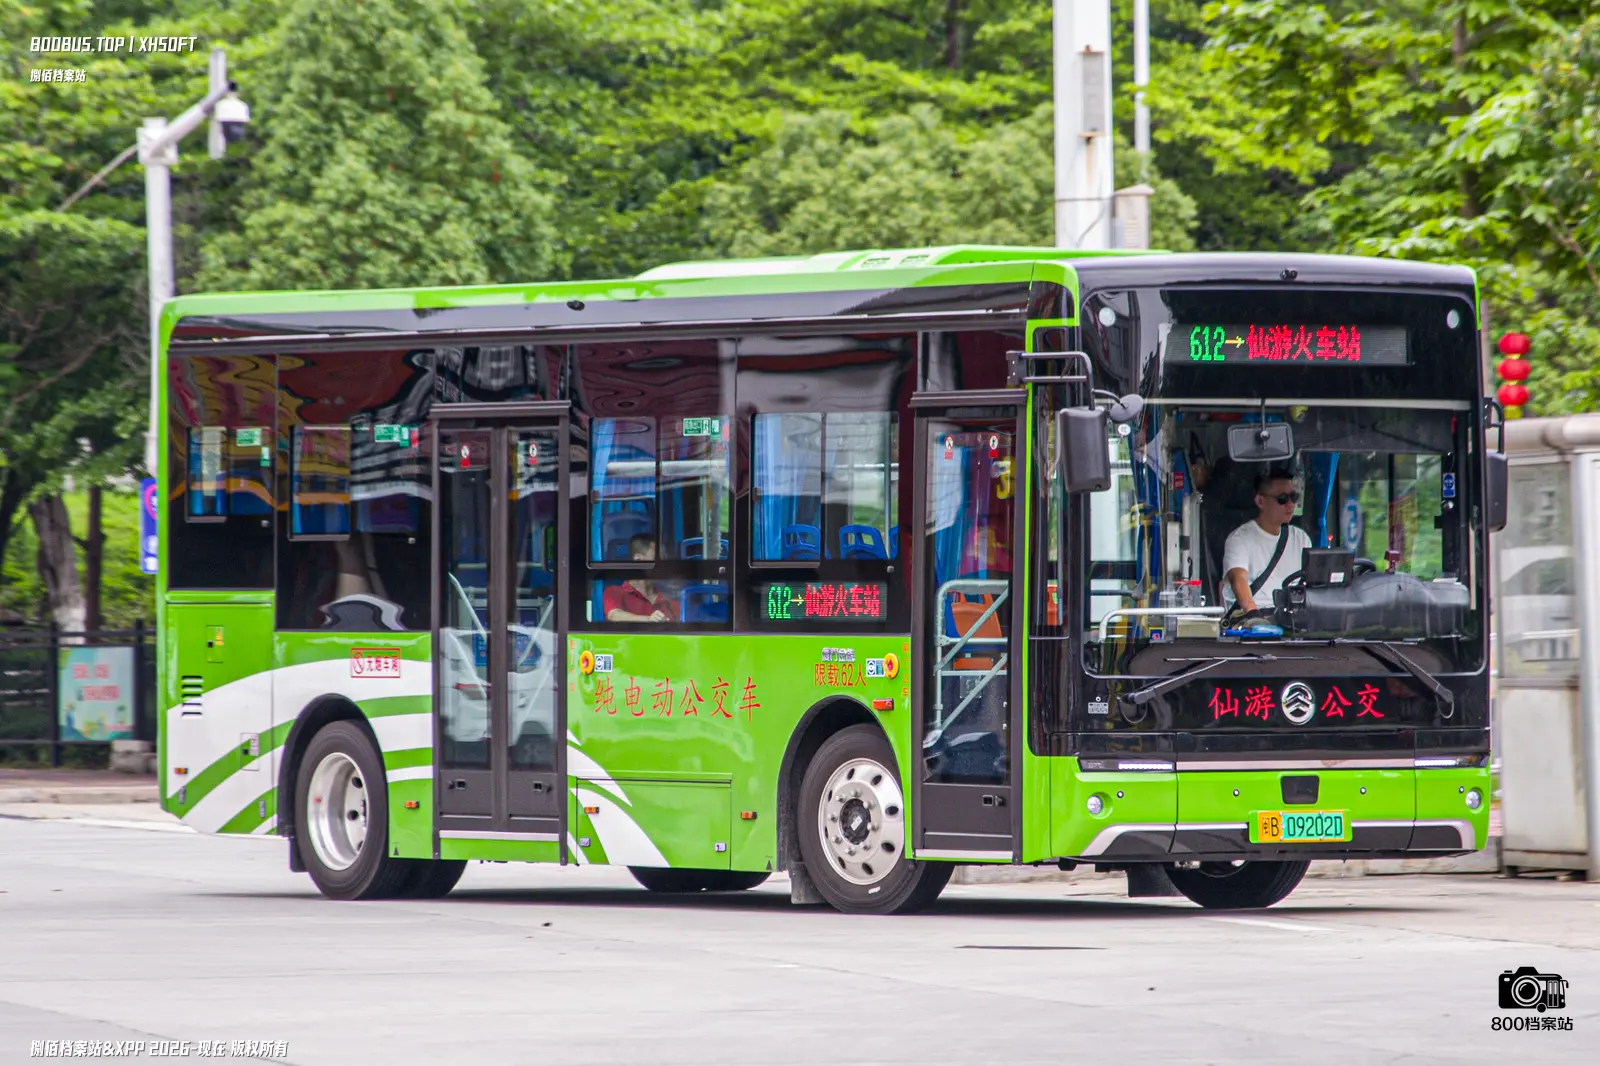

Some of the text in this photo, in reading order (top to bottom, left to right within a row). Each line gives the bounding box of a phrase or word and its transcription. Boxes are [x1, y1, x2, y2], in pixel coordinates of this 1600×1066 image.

[1189, 325, 1361, 361] 612 仙游火车站
[767, 584, 881, 619] 612 仙游火车站
[594, 676, 762, 723] 纯电动公交车
[1208, 683, 1385, 721] 仙游 公交
